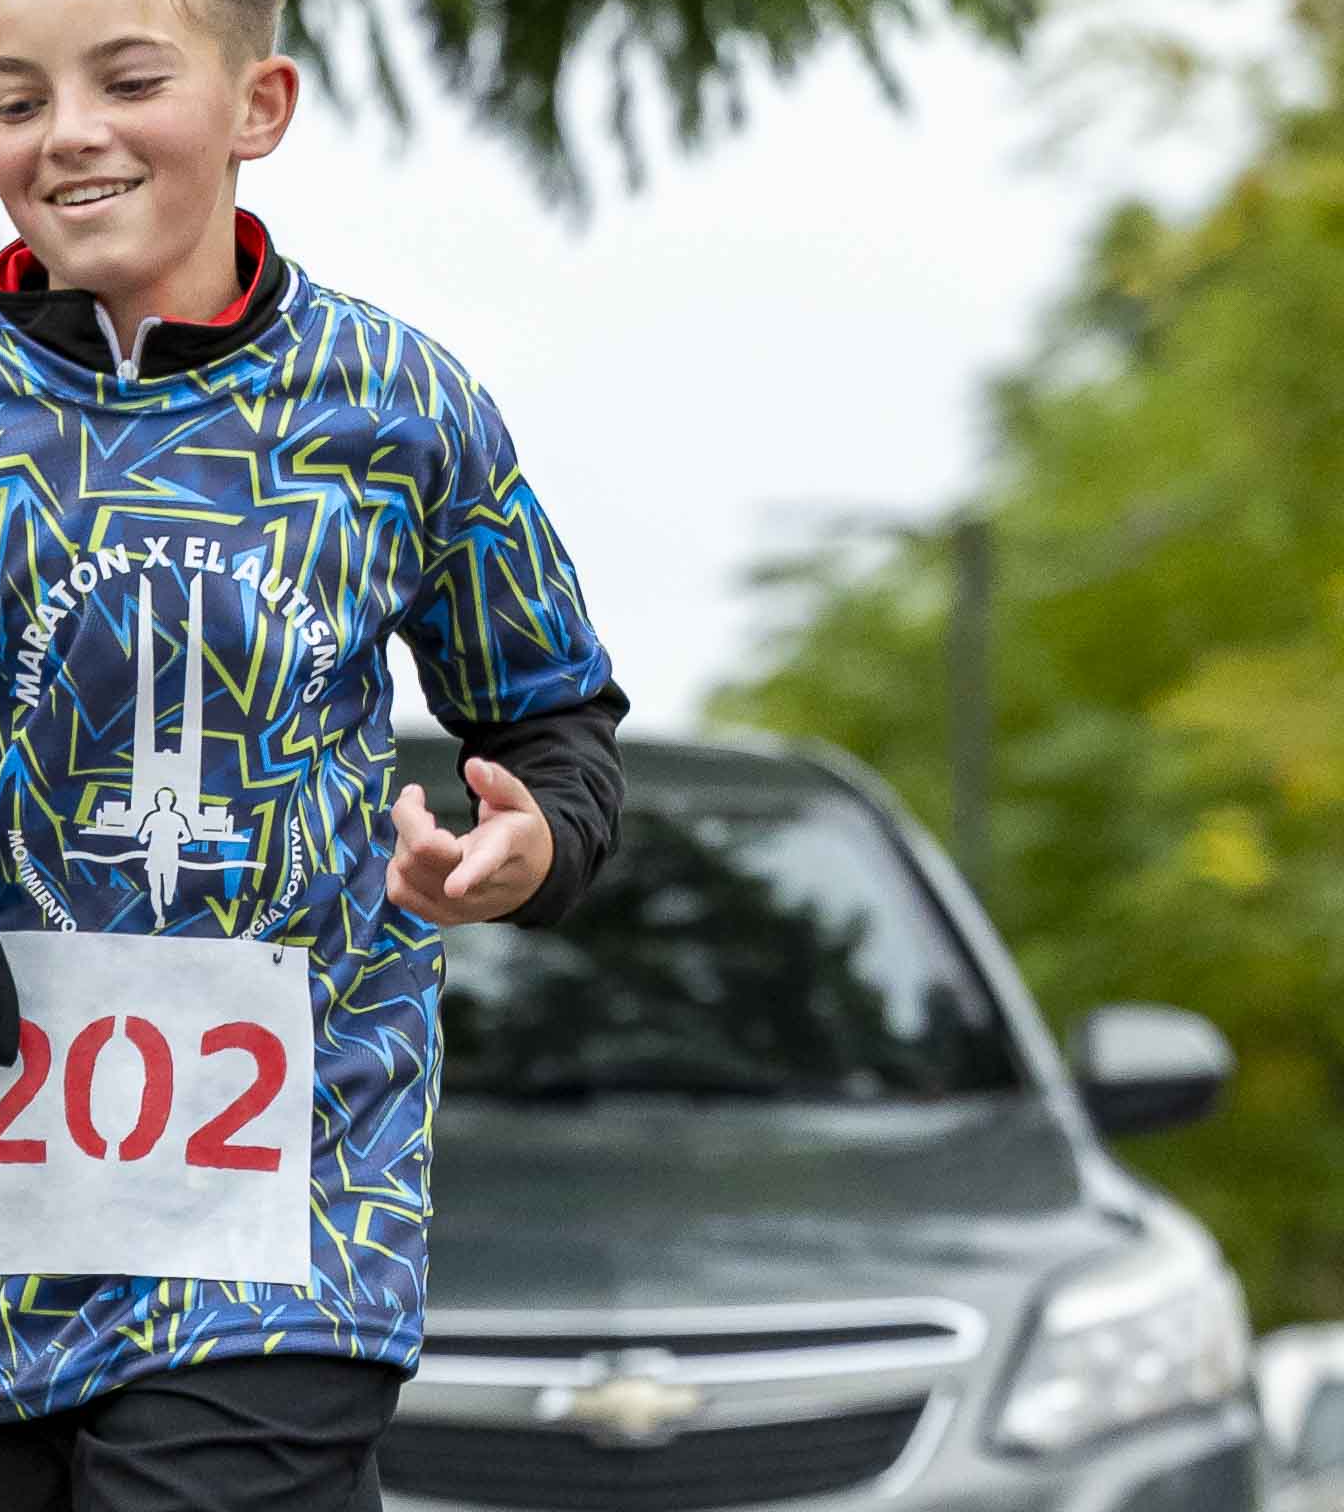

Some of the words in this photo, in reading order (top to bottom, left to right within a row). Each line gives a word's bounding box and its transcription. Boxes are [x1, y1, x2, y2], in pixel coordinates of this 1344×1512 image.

[15, 543, 131, 708] MARATÓN
[142, 536, 173, 569] X
[184, 537, 226, 574] EL
[232, 555, 337, 704] AUTISMO
[7, 829, 77, 934] MOVIMIENTO
[279, 816, 303, 909] POSITIVA
